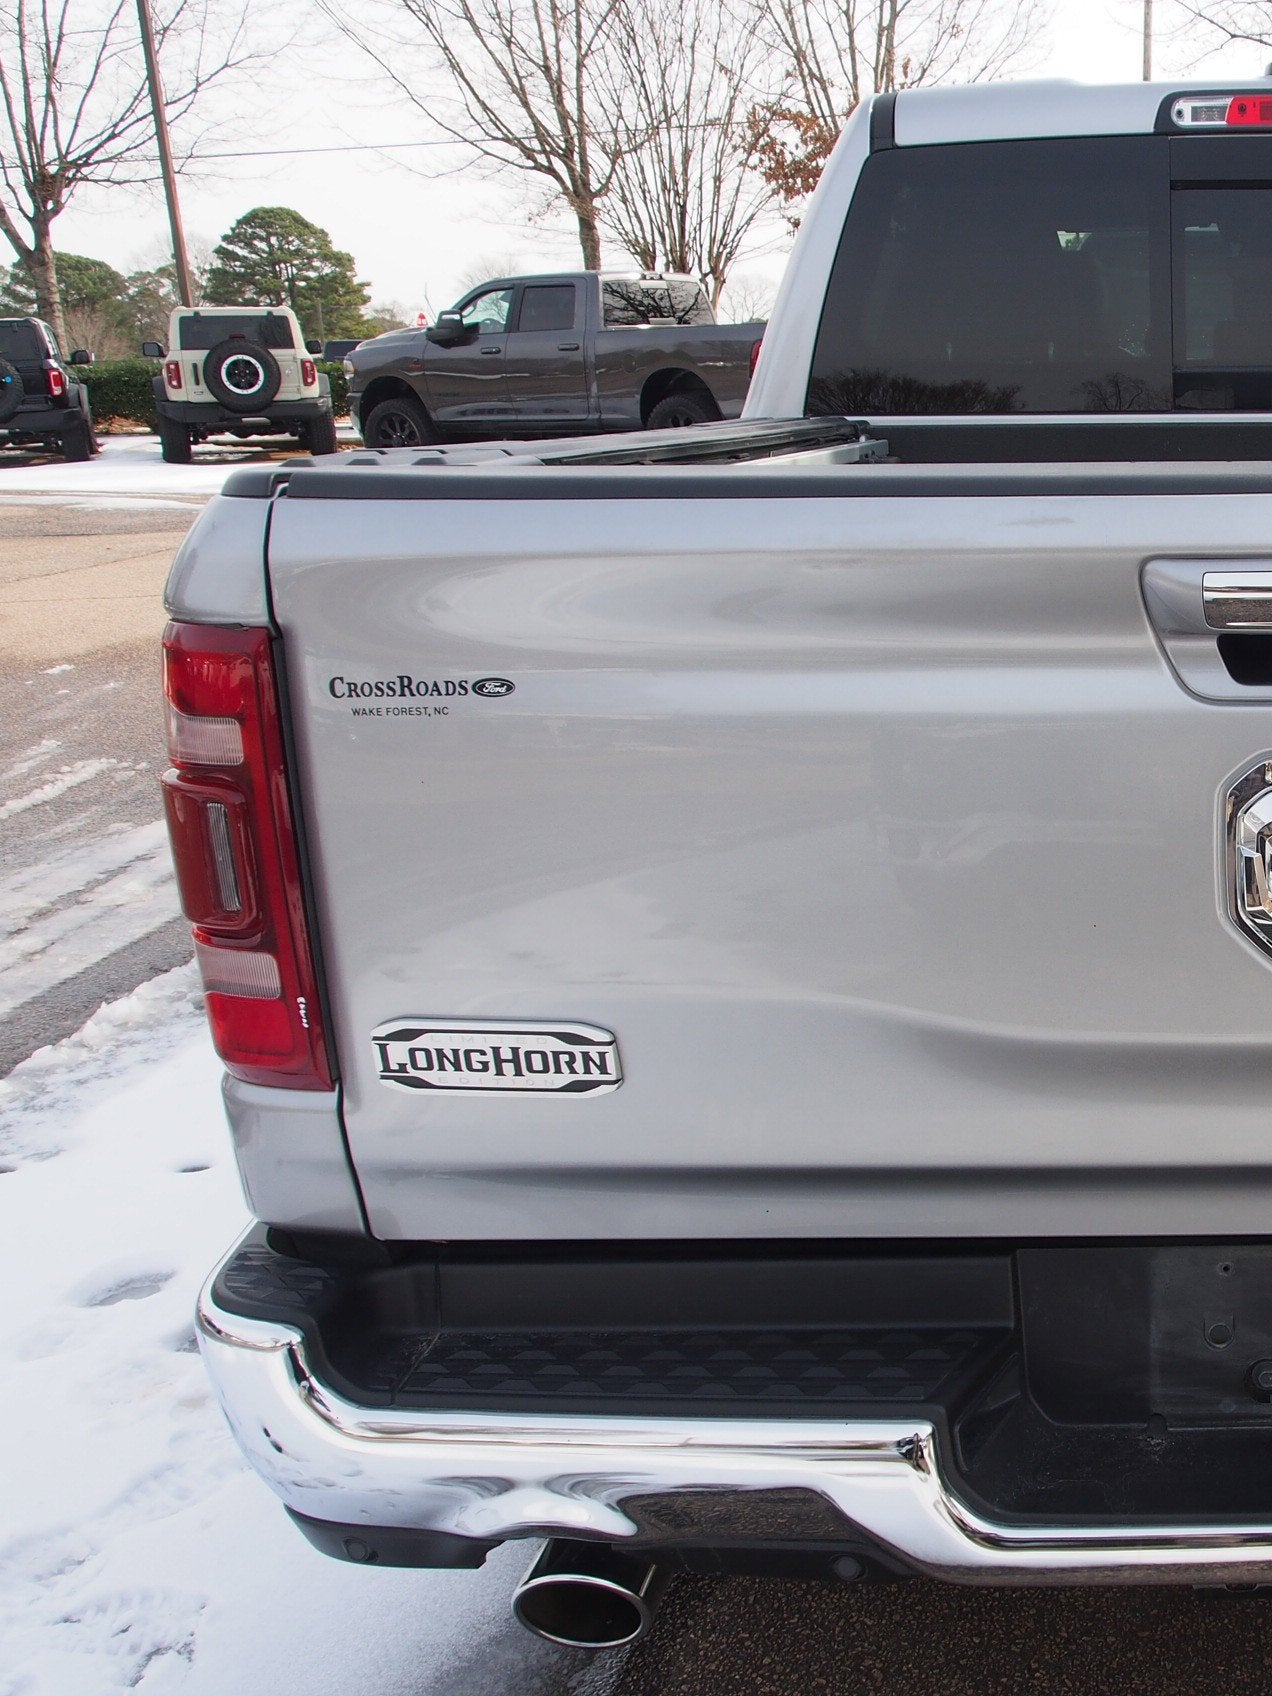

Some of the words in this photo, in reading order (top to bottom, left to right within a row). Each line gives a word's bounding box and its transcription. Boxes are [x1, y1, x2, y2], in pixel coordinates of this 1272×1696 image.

[351, 707, 383, 716] WAKE
[386, 707, 431, 717] FOREST,
[434, 706, 449, 715] NC
[429, 1034, 548, 1045] LIMITED
[438, 1077, 557, 1086] EDITION
